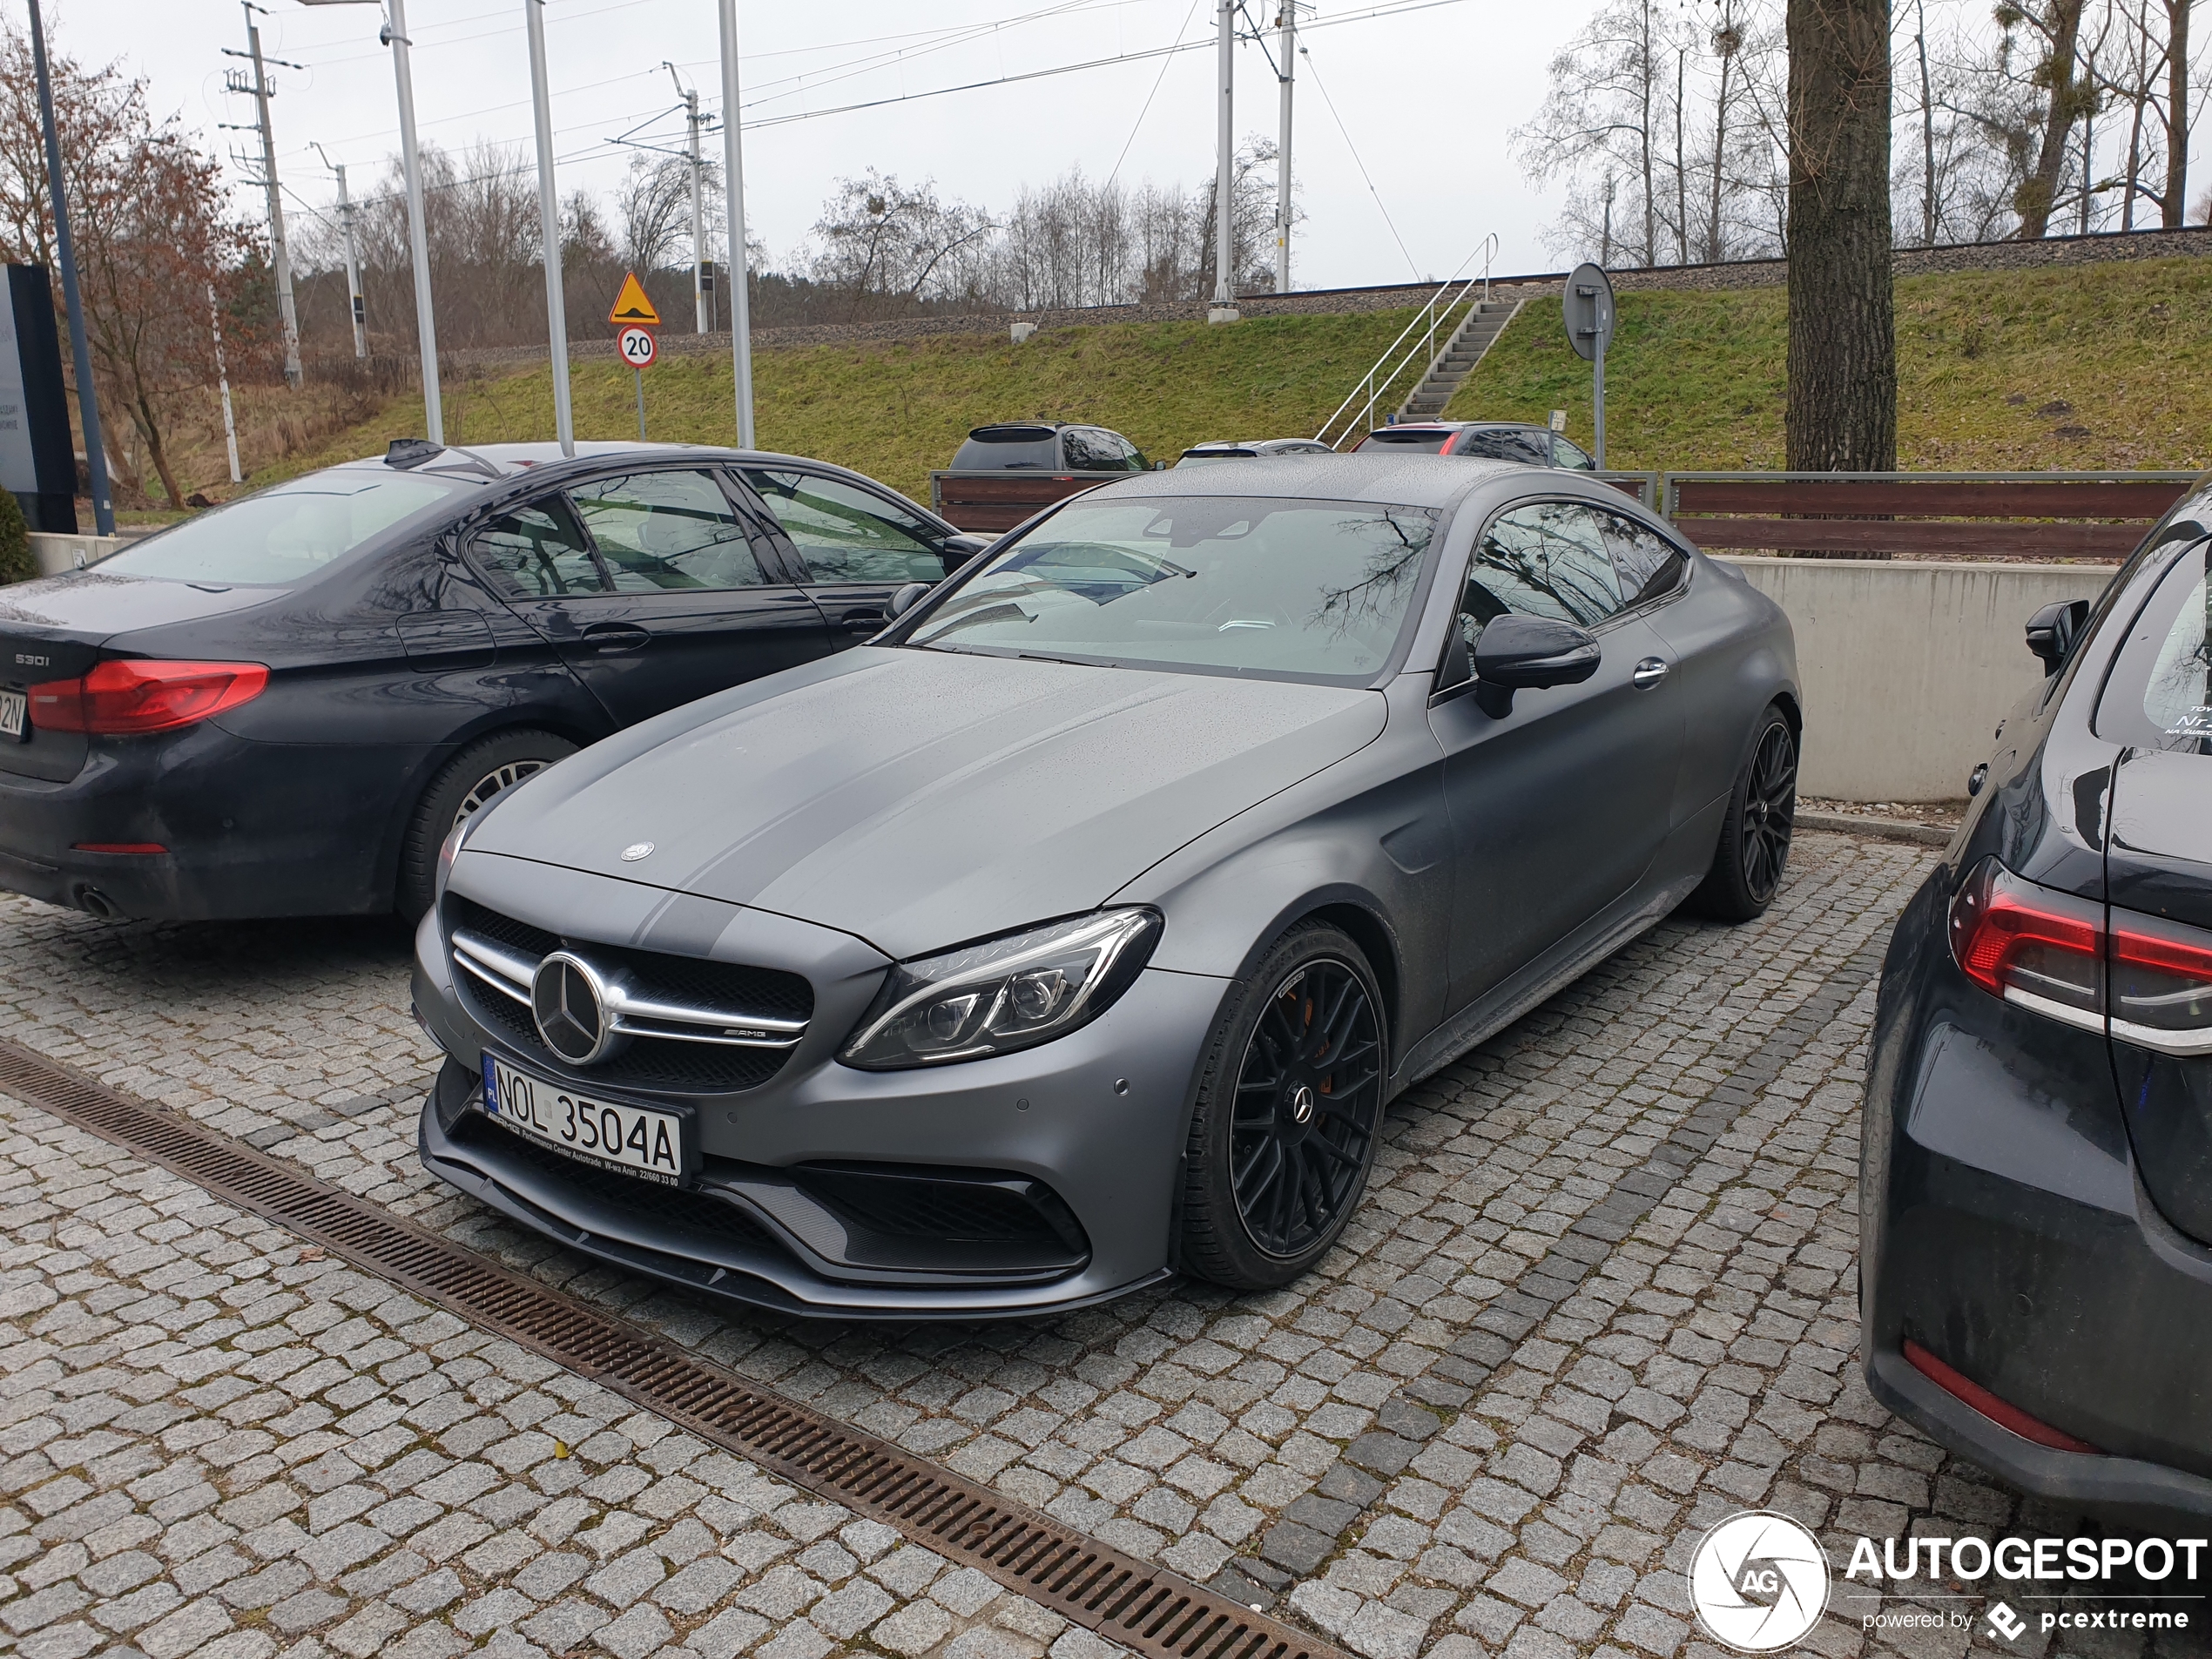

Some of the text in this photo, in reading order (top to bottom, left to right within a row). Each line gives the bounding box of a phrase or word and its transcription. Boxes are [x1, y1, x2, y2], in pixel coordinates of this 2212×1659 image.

[626, 336, 651, 356] 20
[2175, 716, 2208, 726] Nr
[488, 1087, 497, 1103] PL
[496, 1064, 677, 1170] NOL 3504A
[497, 1117, 678, 1187] AMG Performance Center Autotrade W-wa Anin 22/660 33 00
